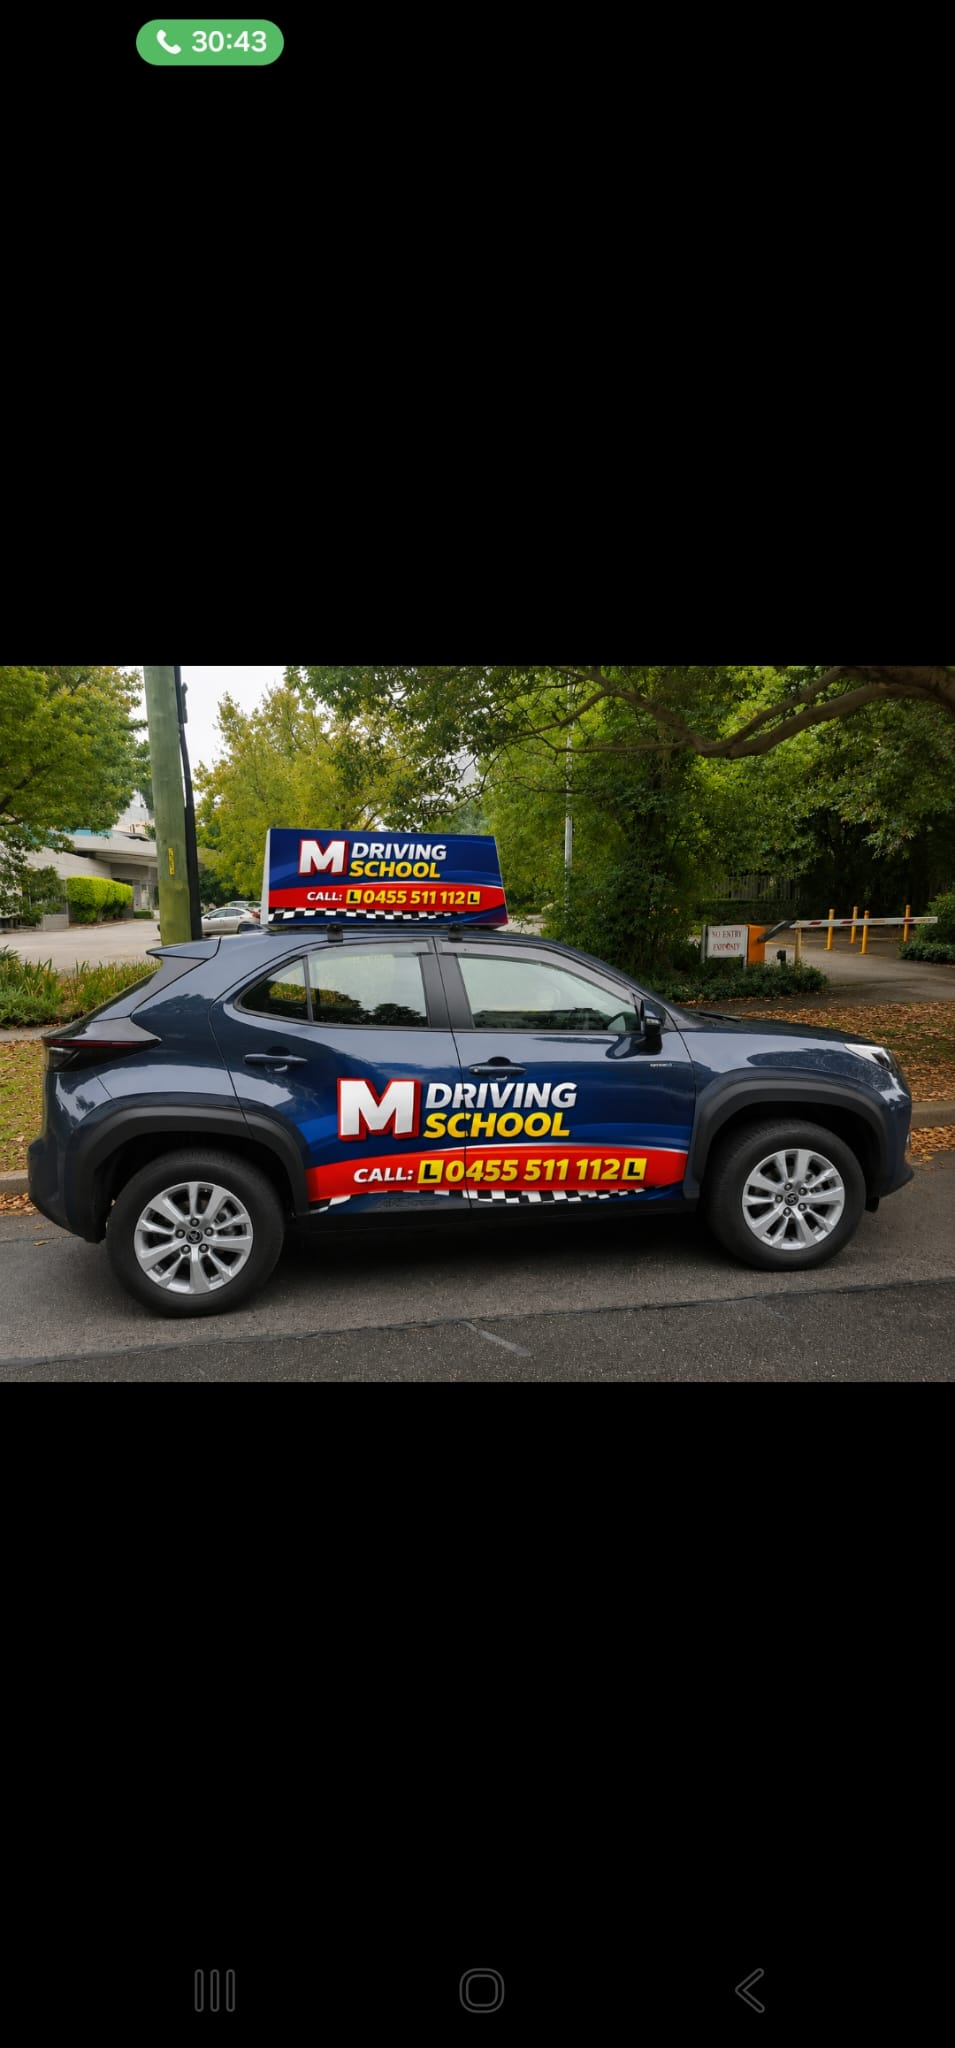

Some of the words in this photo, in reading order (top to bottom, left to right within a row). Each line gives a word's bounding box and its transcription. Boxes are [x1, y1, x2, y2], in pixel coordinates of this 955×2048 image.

[298, 839, 348, 876] M
[351, 842, 447, 860] DRIVING
[349, 861, 441, 878] SCHOOL
[306, 891, 343, 901] CALL:
[363, 890, 407, 904] 0455
[410, 890, 437, 905] 511
[440, 891, 465, 905] 112
[425, 1082, 578, 1109] DRIVING
[337, 1078, 422, 1142] M
[423, 1112, 571, 1138] SCHOOL
[353, 1167, 414, 1183] CALL:
[445, 1159, 519, 1183] 0455
[523, 1158, 570, 1182] 511
[576, 1158, 621, 1181] 112
